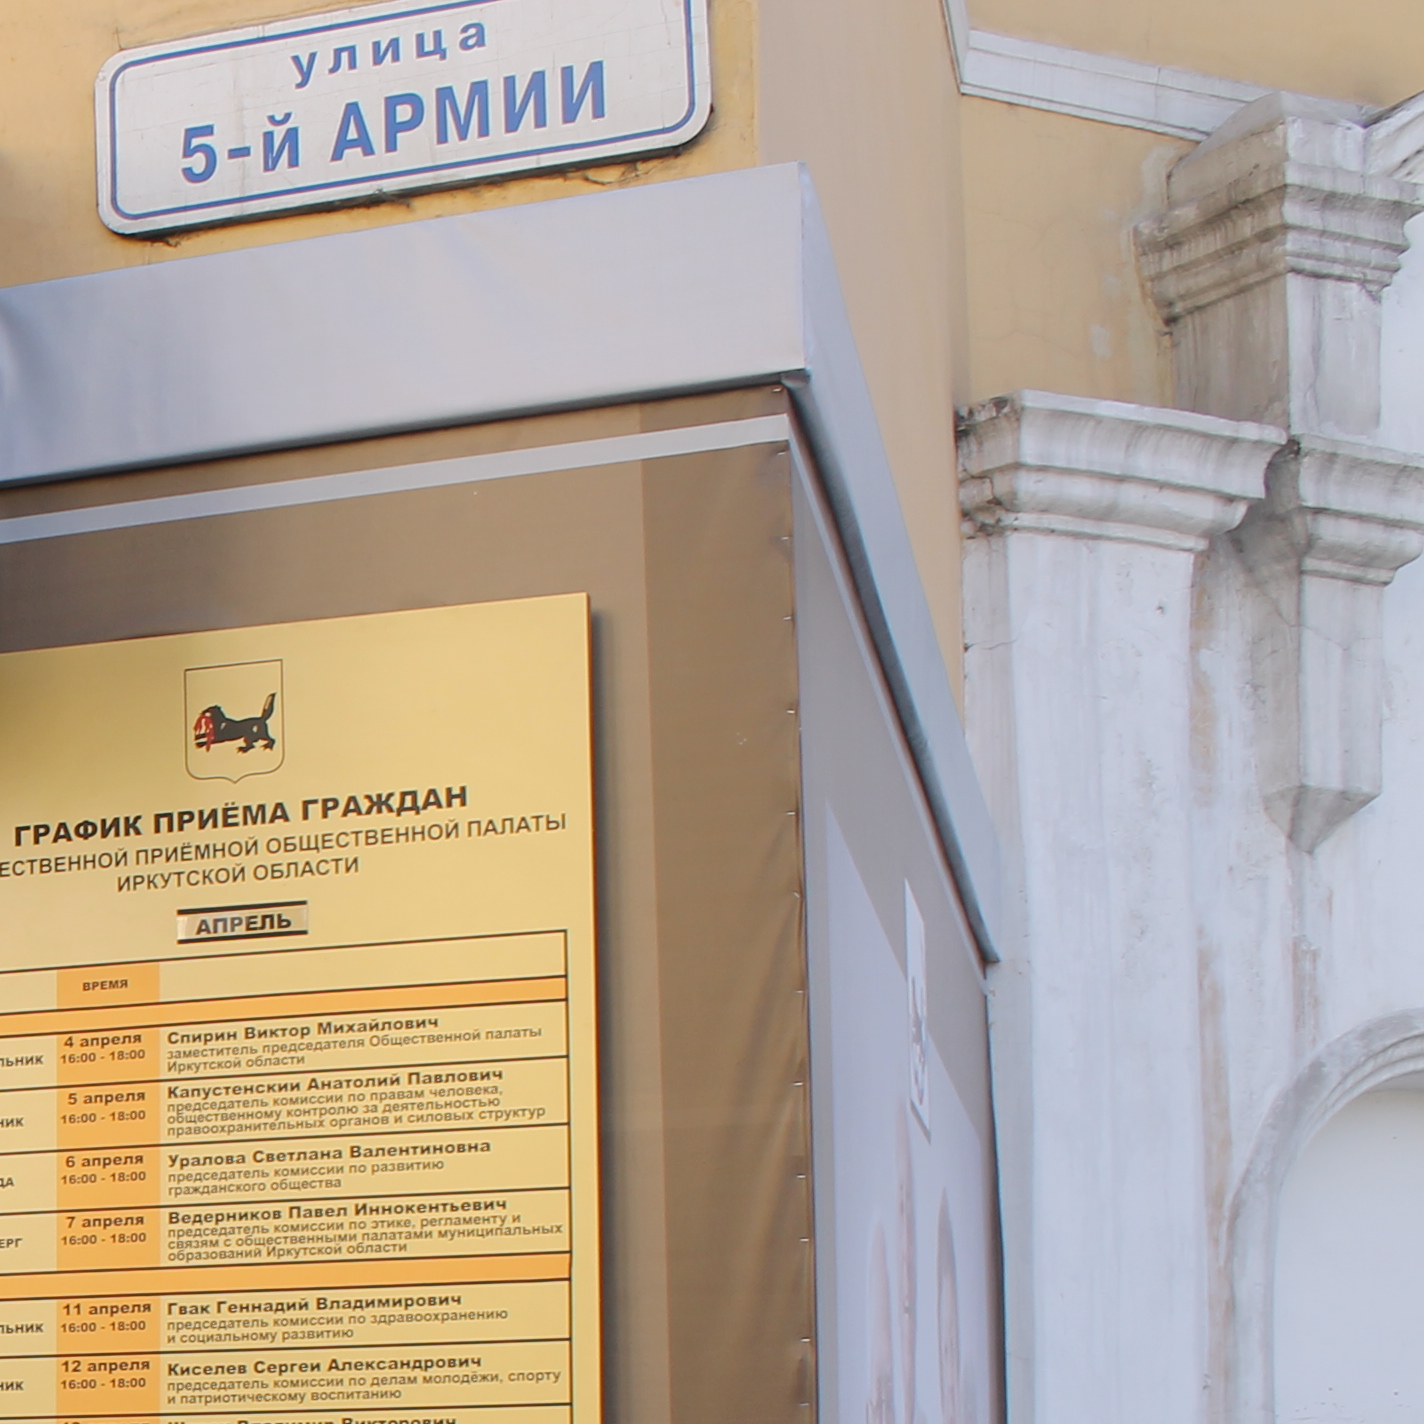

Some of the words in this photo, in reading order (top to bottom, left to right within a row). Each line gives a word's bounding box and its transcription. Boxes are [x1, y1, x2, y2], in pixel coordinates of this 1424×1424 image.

[292, 19, 487, 89] улица
[181, 112, 300, 184] 5-й
[331, 60, 607, 162] АРМИИ
[15, 815, 141, 846] ГРАФИК
[154, 802, 289, 833] ПРИЁМА
[302, 786, 466, 820] ГРАЖДАН
[136, 836, 257, 865] ПРИЁМНОЙ
[266, 819, 458, 853] ОБЩЕСТВЕННОЙ
[468, 813, 565, 837] ПАЛАТЫ
[117, 863, 244, 892] ИРКУТСКОЙ
[253, 852, 358, 880] ОБЛАСТИ
[196, 913, 291, 937] АПРЕЛЬ
[82, 979, 127, 991] ВРЕМЯ
[63, 1036, 73, 1047] 4
[79, 1034, 141, 1049] апреля
[167, 1031, 236, 1045] Спирин
[244, 1026, 310, 1039] Виктор
[317, 1018, 437, 1037] Михайлович
[306, 1073, 399, 1090] Анатолий
[407, 1070, 502, 1088] Павлович
[68, 1093, 76, 1104] 5
[83, 1092, 144, 1106] апреля
[65, 1156, 74, 1167] 6
[81, 1155, 143, 1169] апреля
[252, 1149, 342, 1163] Светлана
[350, 1142, 490, 1158] Валентиновна
[168, 1180, 266, 1197] гражданского
[270, 1178, 341, 1190] общества
[66, 1216, 75, 1228] 7
[81, 1216, 143, 1229] апреля
[168, 1210, 281, 1227] Ведерников
[288, 1206, 346, 1218] Павел
[354, 1200, 506, 1217] Иннокентьевич
[63, 1303, 80, 1315] 11
[88, 1303, 150, 1317] апреля
[168, 1302, 209, 1315] Гвак
[216, 1298, 308, 1313] Геннадий
[316, 1295, 460, 1310] Владимирович
[61, 1360, 80, 1372] 12
[87, 1361, 149, 1374] апреля
[168, 1363, 246, 1376] Киселев
[327, 1357, 480, 1372] Александрович
